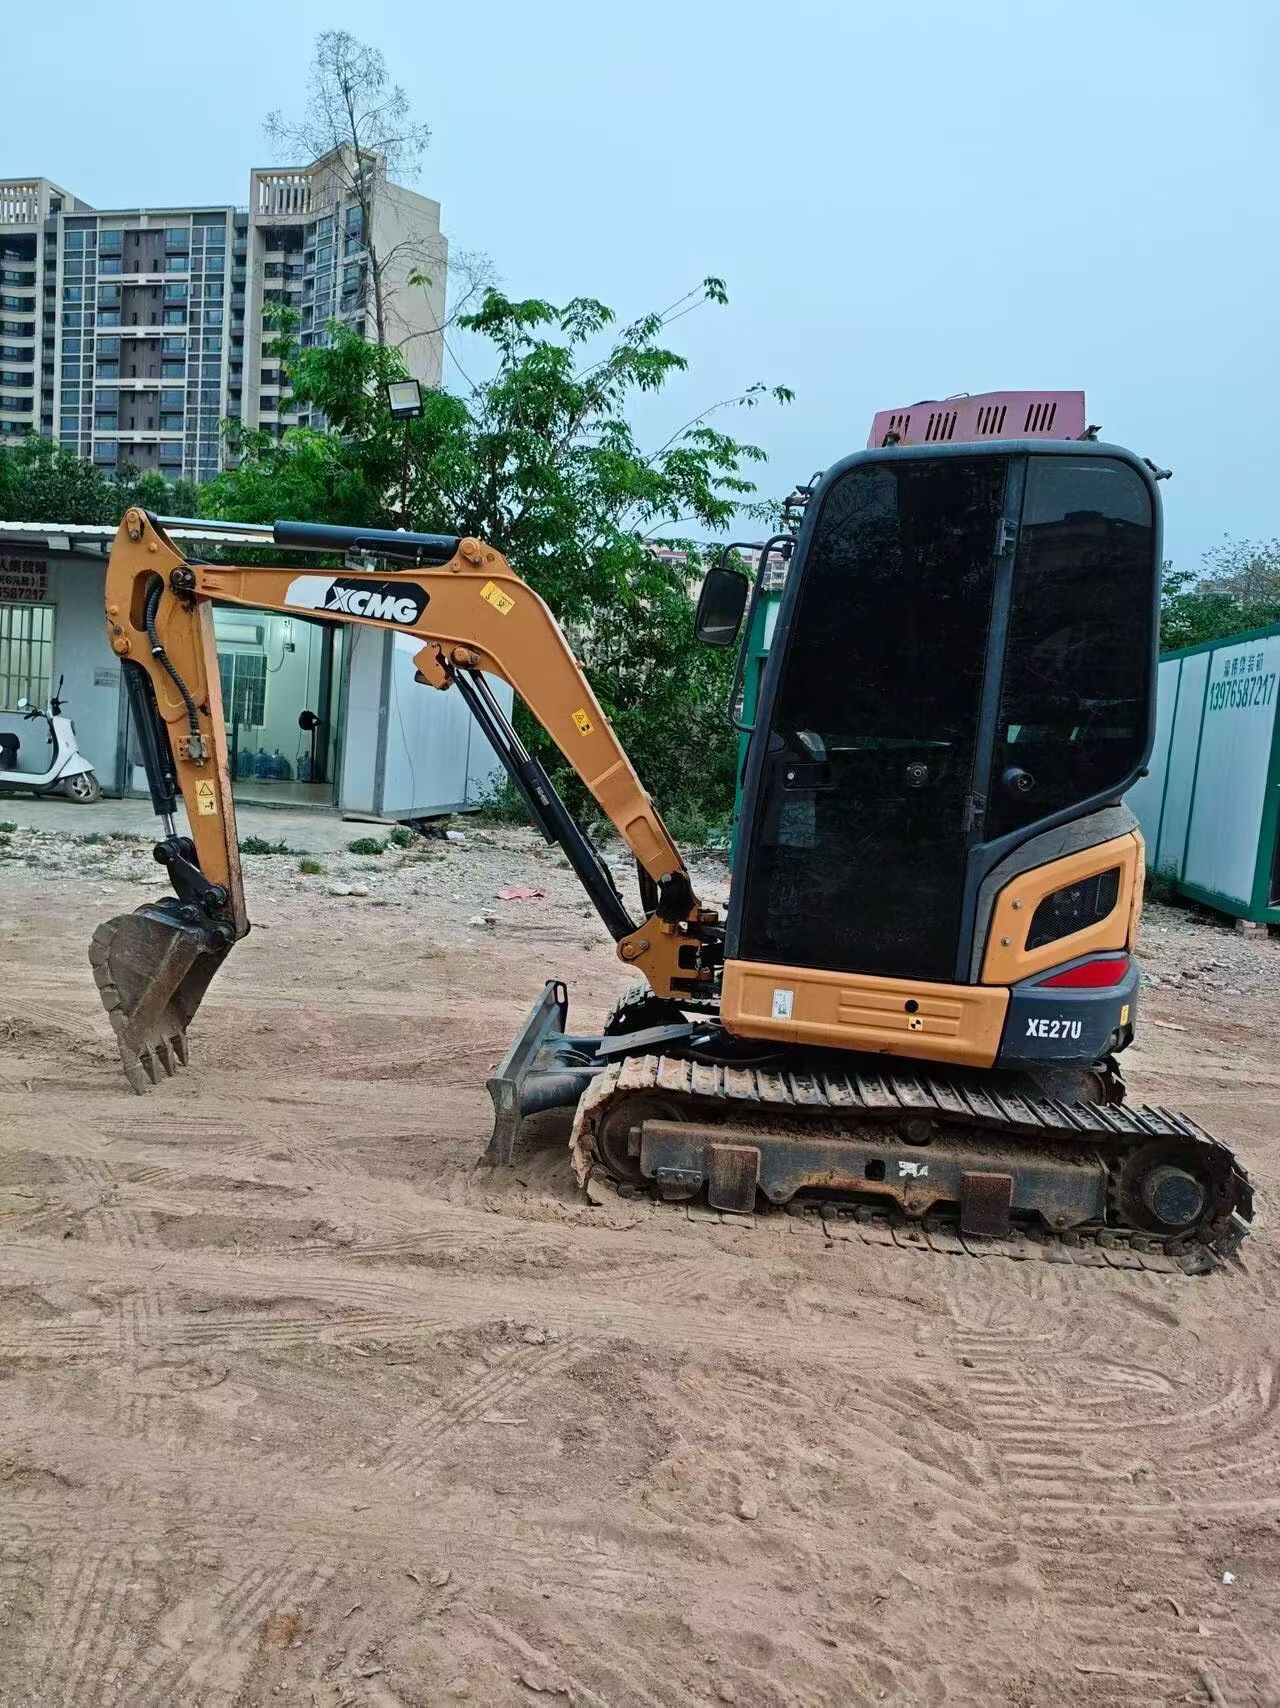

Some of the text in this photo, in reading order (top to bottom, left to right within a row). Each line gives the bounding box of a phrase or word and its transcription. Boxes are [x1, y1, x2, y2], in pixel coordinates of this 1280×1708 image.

[0, 587, 47, 601] 587217
[324, 586, 418, 623] XCMG
[1209, 673, 1276, 711] 13976587217
[1025, 1018, 1082, 1039] XE27U
